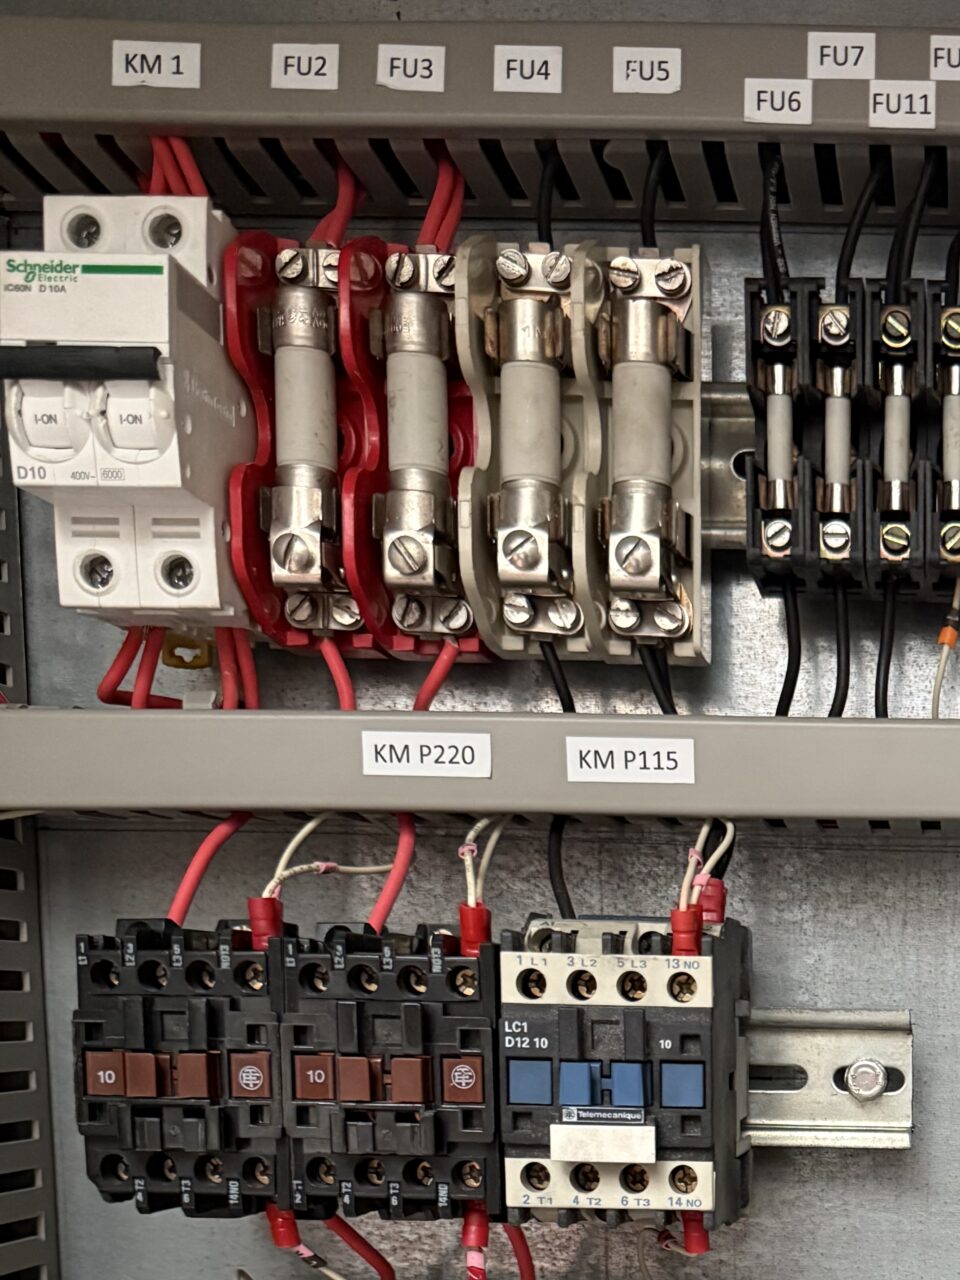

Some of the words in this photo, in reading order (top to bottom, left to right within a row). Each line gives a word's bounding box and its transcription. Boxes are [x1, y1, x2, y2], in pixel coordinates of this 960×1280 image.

[819, 45, 865, 66] FU7
[124, 53, 162, 74] KM
[171, 54, 184, 75] 1
[283, 55, 327, 76] FU2
[389, 57, 433, 79] FU3
[505, 59, 551, 80] FU4
[626, 60, 670, 81] FU5
[756, 90, 802, 112] FU6
[872, 93, 932, 115] FU11
[6, 259, 79, 274] Schneider
[38, 273, 78, 283] Electric
[17, 466, 47, 480] D10
[374, 743, 411, 764] KM
[419, 744, 476, 765] P220
[579, 749, 615, 769] KM
[624, 750, 679, 771] P115
[567, 956, 575, 967] 3
[617, 957, 625, 968] 5
[665, 958, 680, 969] 13
[684, 961, 700, 969] NO
[505, 1021, 528, 1033] LC1
[505, 1036, 530, 1048] D12
[533, 1038, 549, 1049] 10
[659, 1039, 672, 1049] 10
[97, 1070, 116, 1084] 10
[306, 1069, 325, 1084] 10
[577, 1110, 642, 1120] Telemecanique
[522, 1194, 530, 1205] 2
[572, 1195, 580, 1205] 4
[587, 1197, 602, 1206] T2
[620, 1196, 629, 1206] 6
[634, 1198, 651, 1206] T3
[668, 1196, 683, 1207] 14
[686, 1199, 702, 1208] NO
